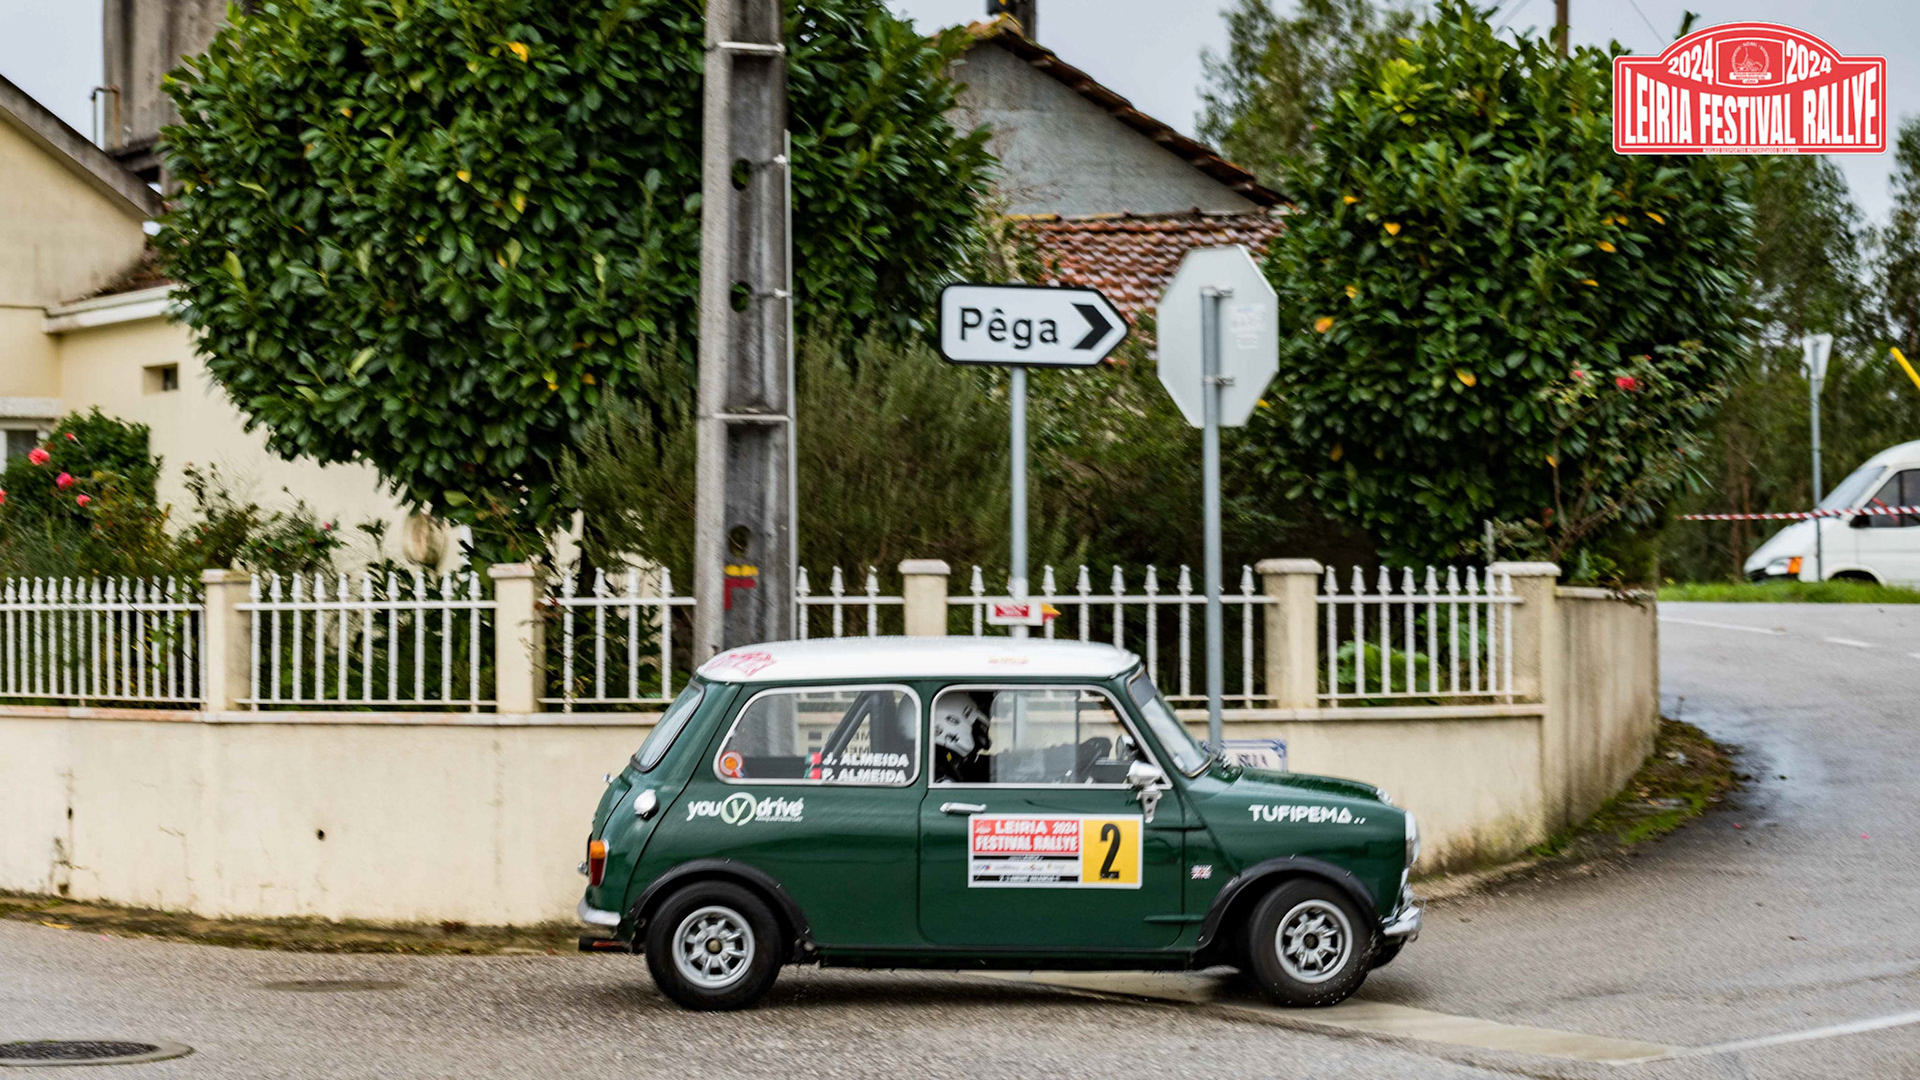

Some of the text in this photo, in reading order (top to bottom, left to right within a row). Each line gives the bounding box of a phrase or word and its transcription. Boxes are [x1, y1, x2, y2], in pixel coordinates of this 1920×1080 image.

[960, 308, 1059, 350] Pêga
[840, 752, 910, 768] ALMEIDA
[837, 768, 907, 783] ALMEIDA
[995, 820, 1048, 834] LEIRIA
[974, 835, 1078, 851] FESTIVAL RALLYE
[1100, 823, 1121, 879] 2
